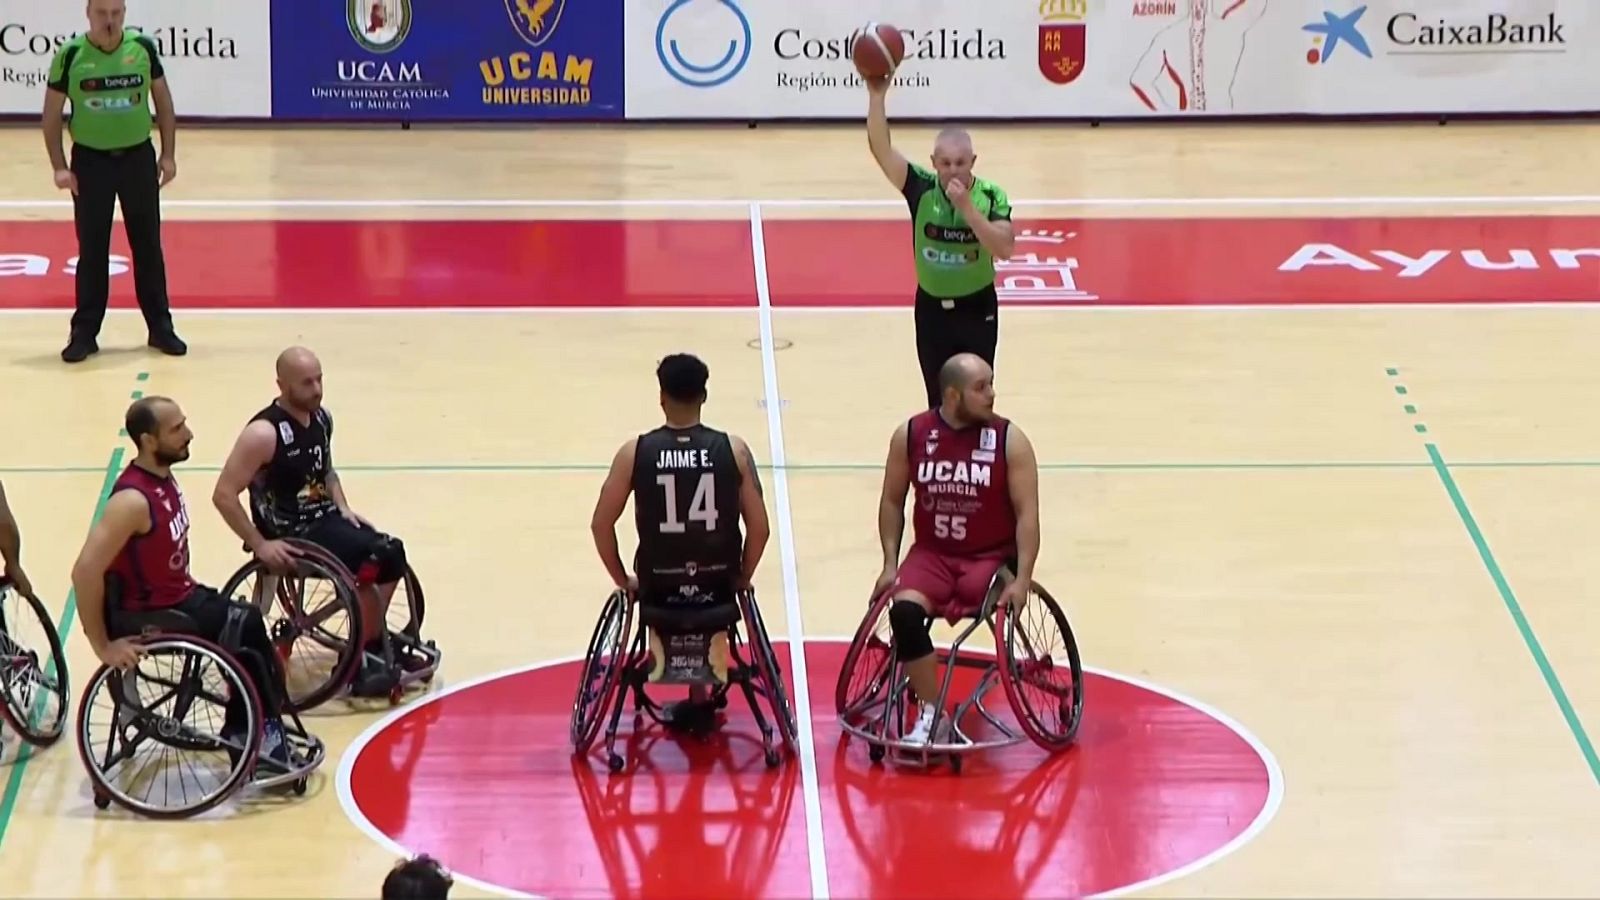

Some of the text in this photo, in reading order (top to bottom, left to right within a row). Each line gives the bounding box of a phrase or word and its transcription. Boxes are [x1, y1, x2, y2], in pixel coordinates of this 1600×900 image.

[1386, 12, 1566, 46] CaixaBank
[337, 60, 422, 82] UCAM
[479, 51, 593, 86] UCAM
[776, 72, 837, 92] Región
[482, 87, 591, 105] UNIVERSIDAD
[656, 449, 714, 469] JAIME E.
[917, 460, 991, 487] UCAM
[927, 482, 978, 497] MURCIA
[656, 472, 719, 533] 14
[934, 513, 967, 541] 55
